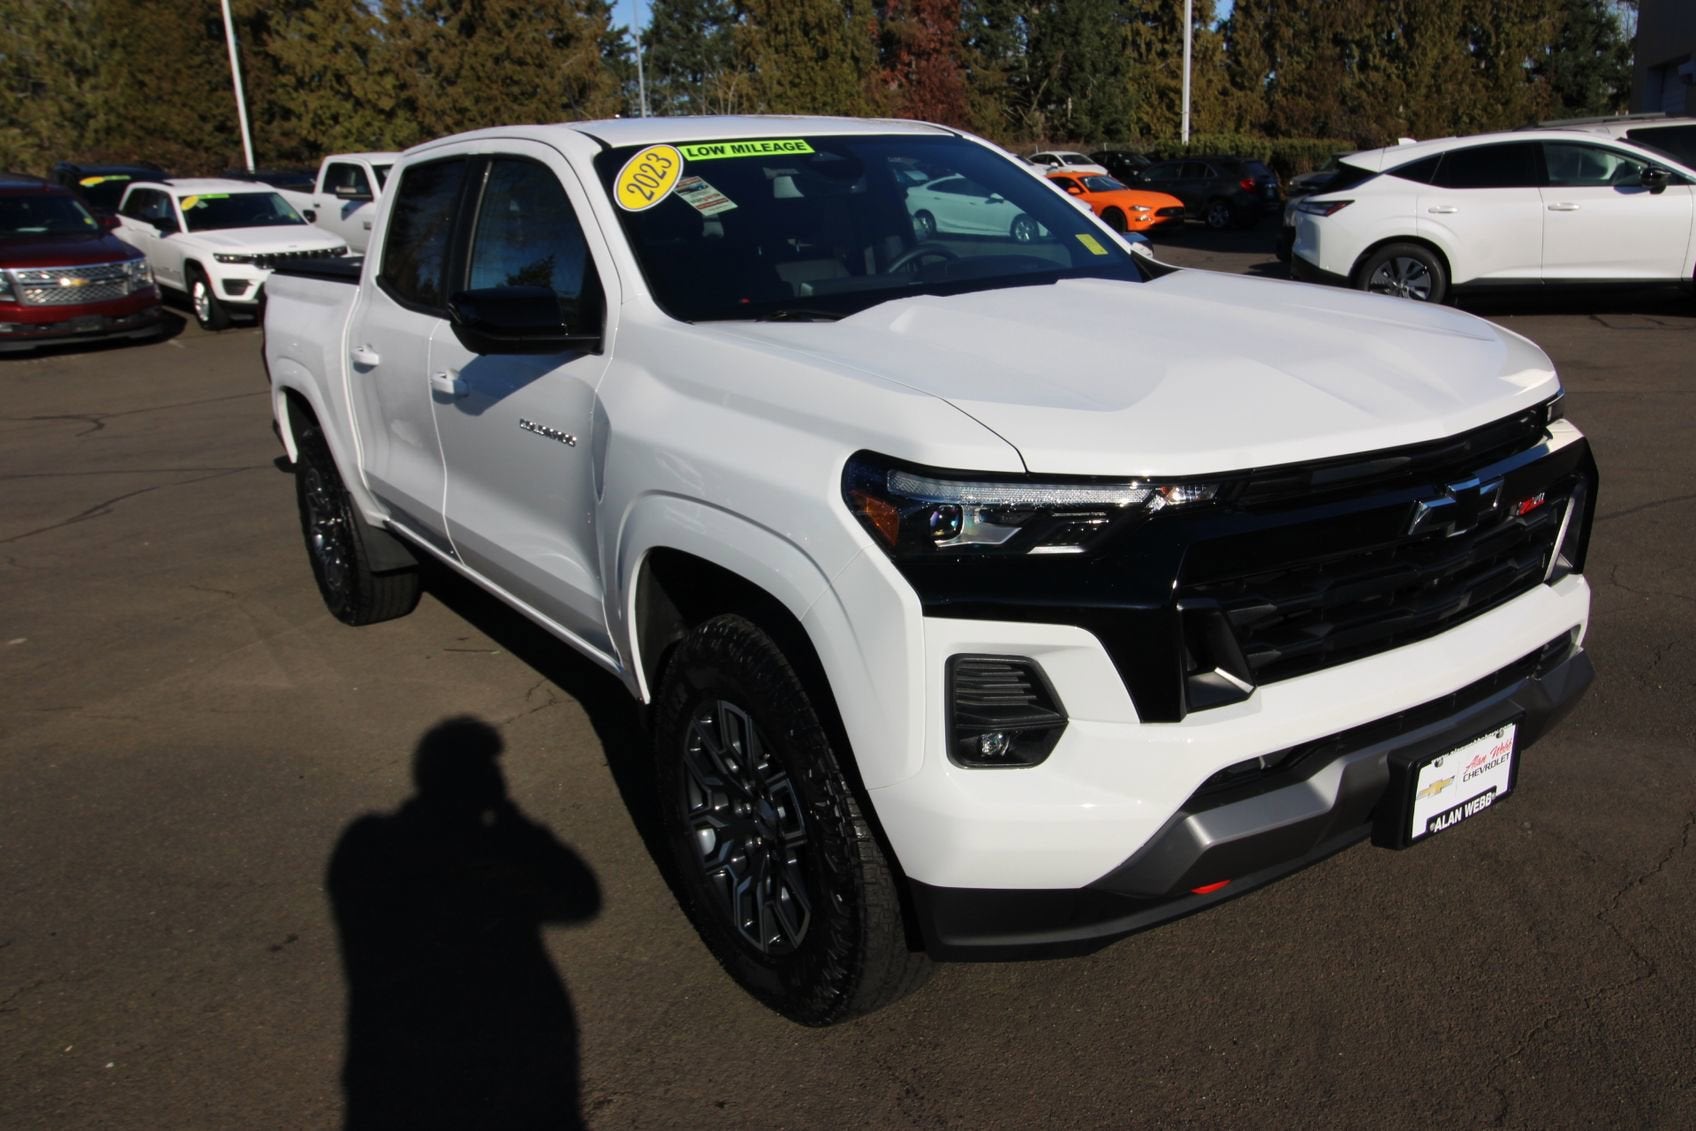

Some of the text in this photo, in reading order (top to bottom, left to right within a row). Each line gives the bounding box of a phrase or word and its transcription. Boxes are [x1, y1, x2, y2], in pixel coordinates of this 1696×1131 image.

[686, 141, 807, 157] LOW MILEAGE
[626, 152, 672, 201] 2023
[1462, 752, 1511, 782] CHEVROLET
[1434, 792, 1492, 833] ALAN WEBB
